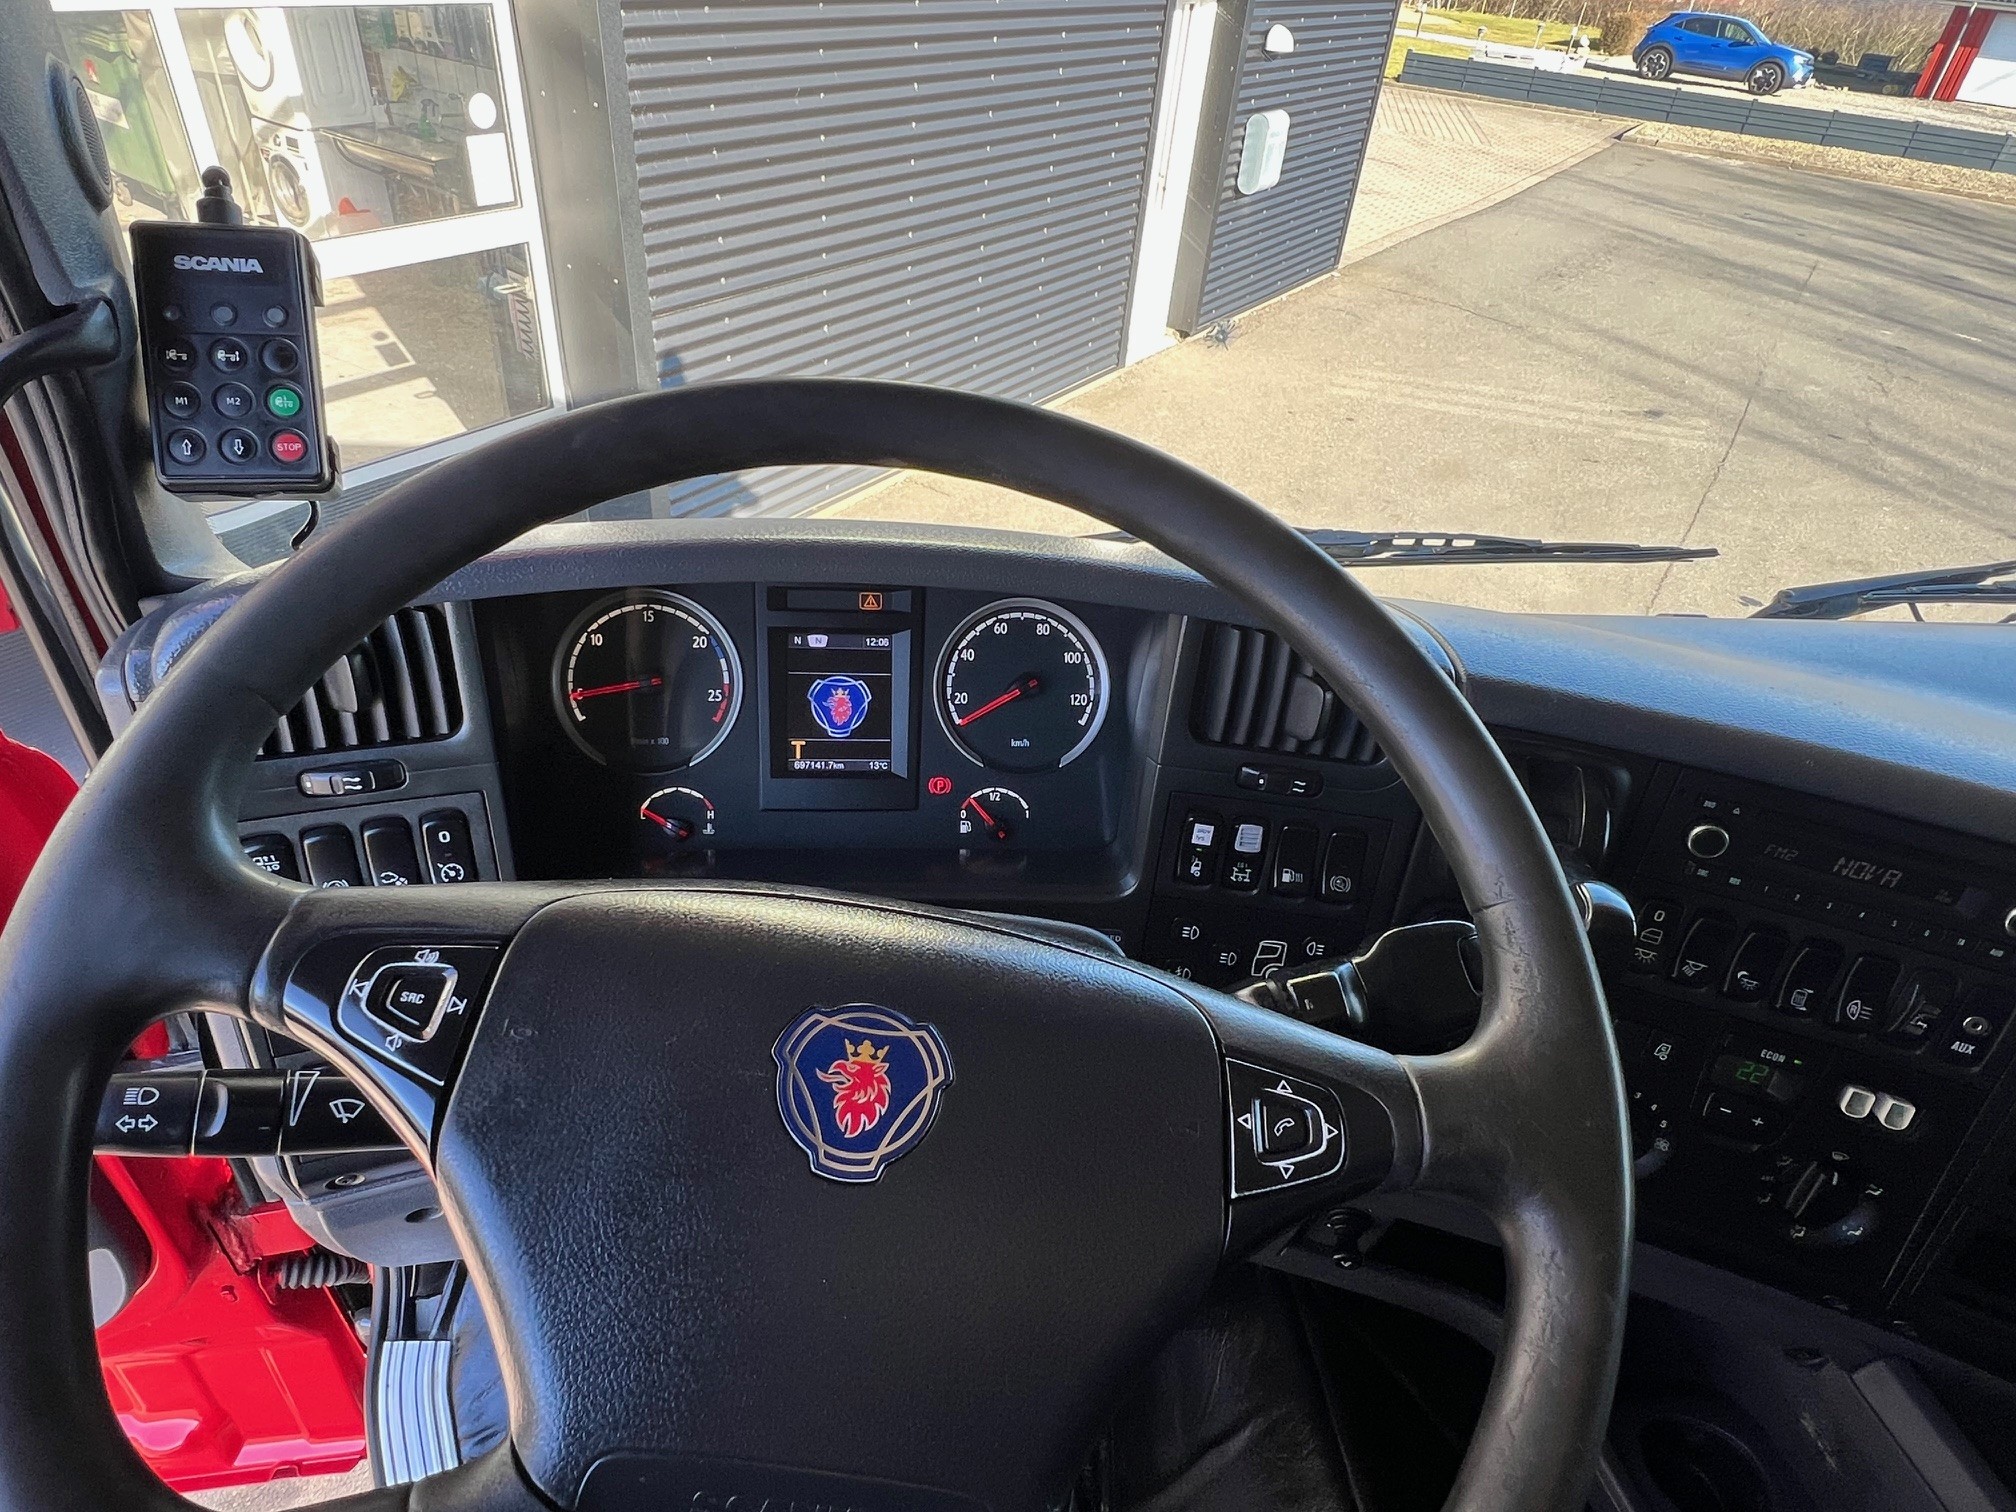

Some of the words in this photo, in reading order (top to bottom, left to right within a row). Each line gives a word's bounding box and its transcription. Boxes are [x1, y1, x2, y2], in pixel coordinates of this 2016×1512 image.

[173, 255, 264, 274] SCANIA
[175, 396, 189, 406] M1
[226, 397, 241, 406] M2
[277, 443, 302, 452] STOP
[642, 611, 655, 623] 15
[994, 623, 1008, 635] 60
[1036, 623, 1050, 635] 80
[590, 633, 603, 646] 10
[692, 636, 708, 648] 20
[794, 636, 802, 645] N
[960, 649, 975, 661] 40
[1064, 652, 1082, 664] 100
[707, 690, 723, 702] 25
[954, 693, 968, 705] 20
[1070, 694, 1087, 706] 120
[1010, 739, 1030, 748] km/h
[989, 792, 1001, 802] 1/2
[707, 810, 715, 820] H
[960, 809, 967, 819] 0
[1025, 810, 1030, 819] 1
[438, 831, 450, 843] 0
[1764, 844, 1799, 861] FM2
[1653, 910, 1666, 922] 0
[400, 991, 425, 1005] SRC
[1950, 1041, 1976, 1055] AUX
[1760, 1048, 1786, 1063] ECON
[1735, 1060, 1770, 1085] 22
